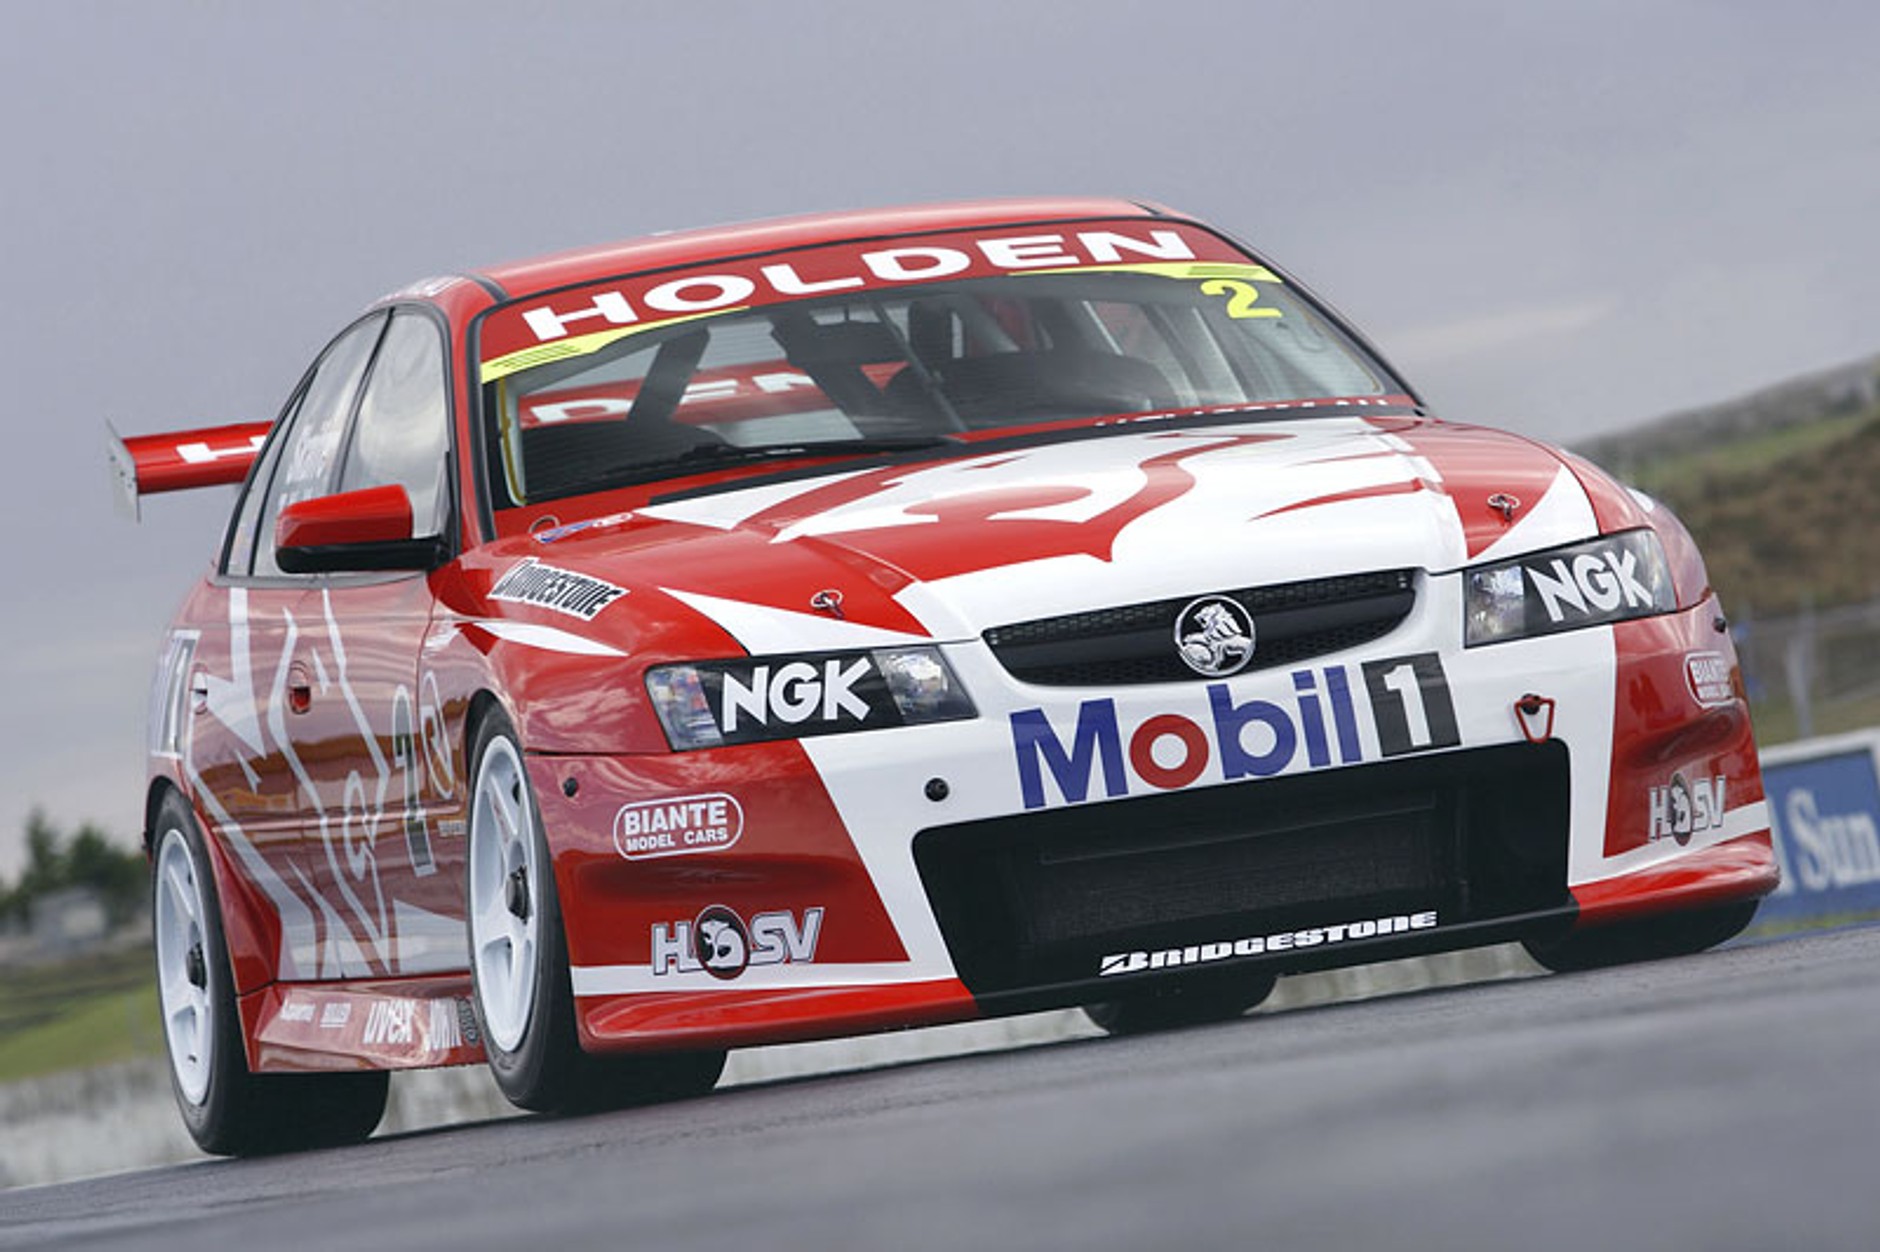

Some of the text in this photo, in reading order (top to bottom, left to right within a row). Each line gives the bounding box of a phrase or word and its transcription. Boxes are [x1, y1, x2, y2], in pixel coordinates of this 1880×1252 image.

[522, 231, 1195, 341] HOLDEN
[1201, 279, 1282, 319] 2
[1524, 549, 1654, 622] NGK
[722, 655, 872, 733] NGK
[1009, 664, 1362, 810] Mobil
[624, 800, 728, 836] BIANTE
[627, 827, 728, 852] MODEL CARS
[1099, 911, 1438, 976] BRIDGESTONE
